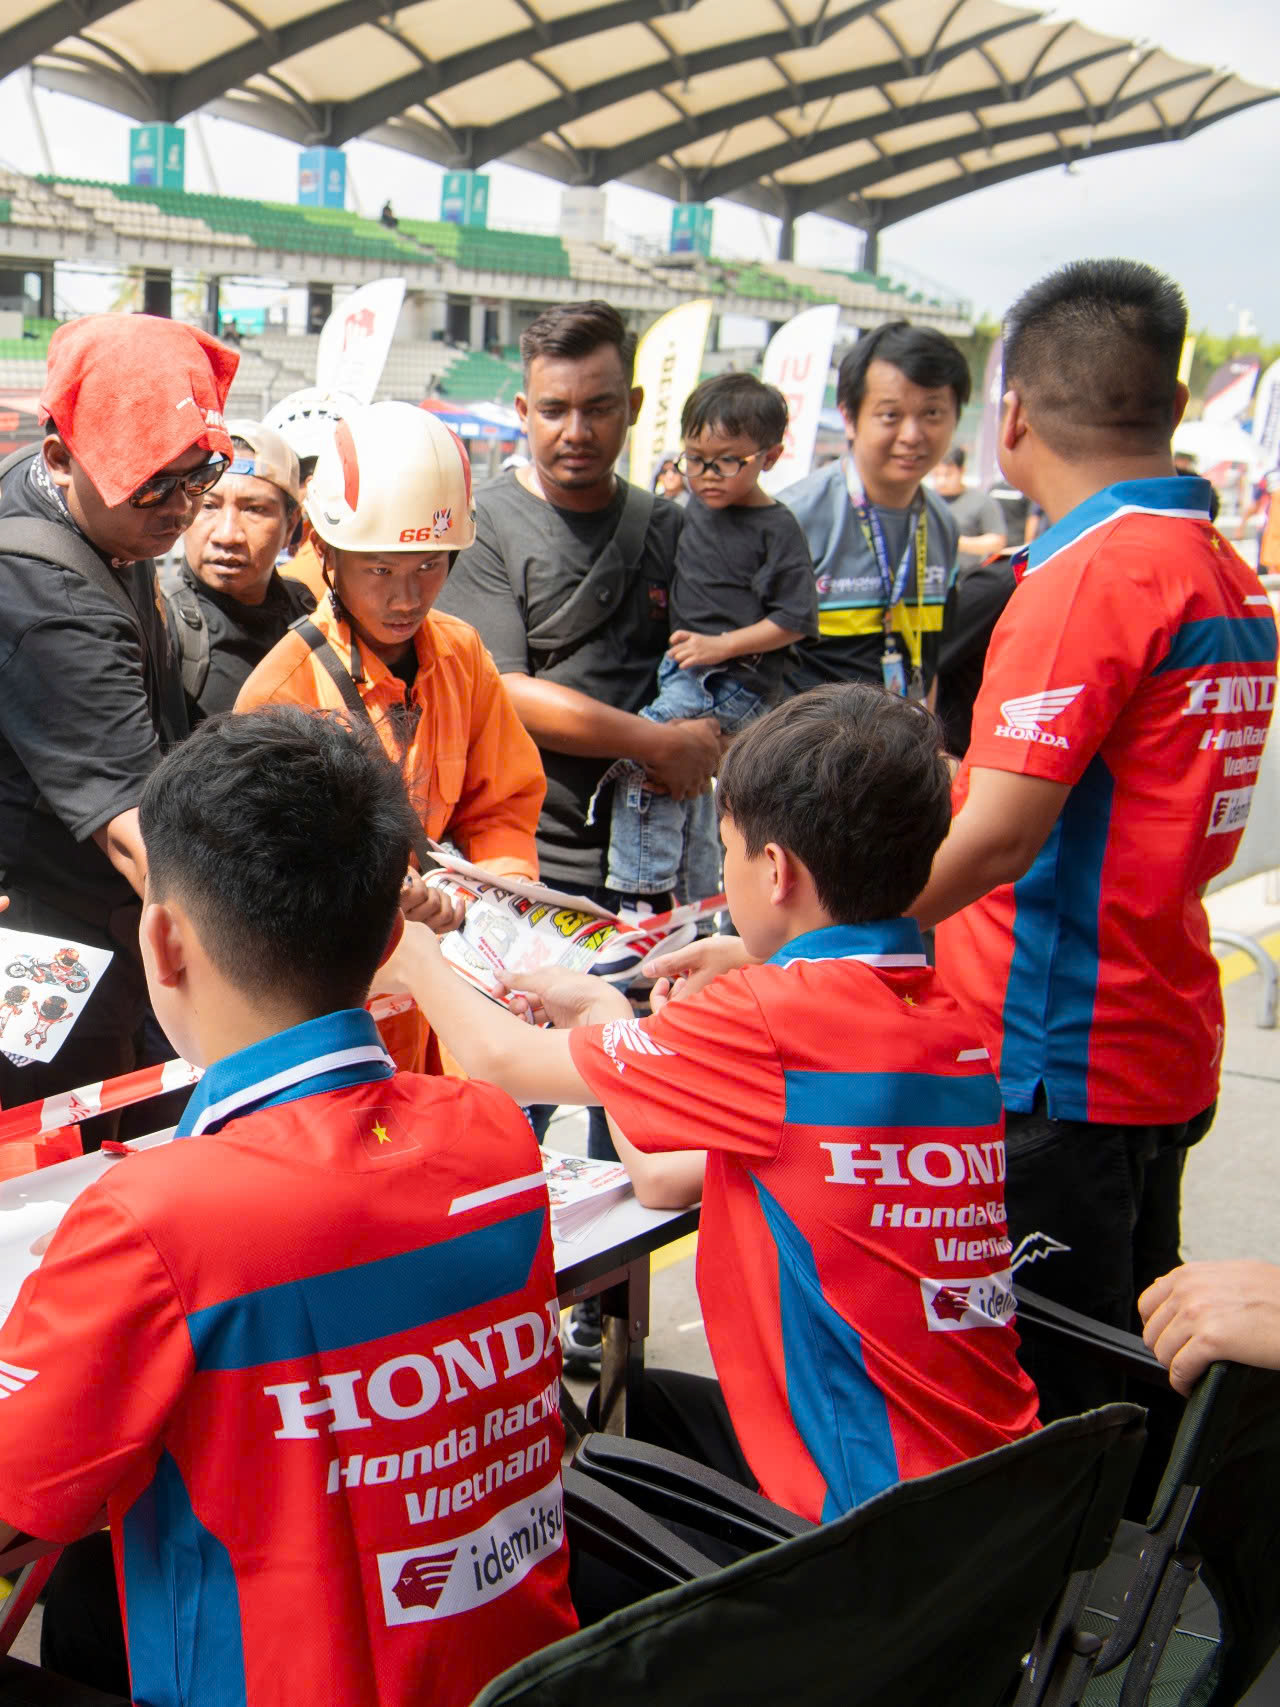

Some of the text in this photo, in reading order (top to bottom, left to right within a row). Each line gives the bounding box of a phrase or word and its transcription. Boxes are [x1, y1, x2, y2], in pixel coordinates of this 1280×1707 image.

[399, 527, 431, 543] 66
[1181, 675, 1277, 715] HOND
[994, 724, 1070, 750] HONDA
[820, 1141, 1006, 1187] HOND
[870, 1202, 987, 1228] Honda
[327, 1425, 477, 1495] Honda
[405, 1435, 550, 1525] Vietnam
[471, 1500, 563, 1592] idemitsu
